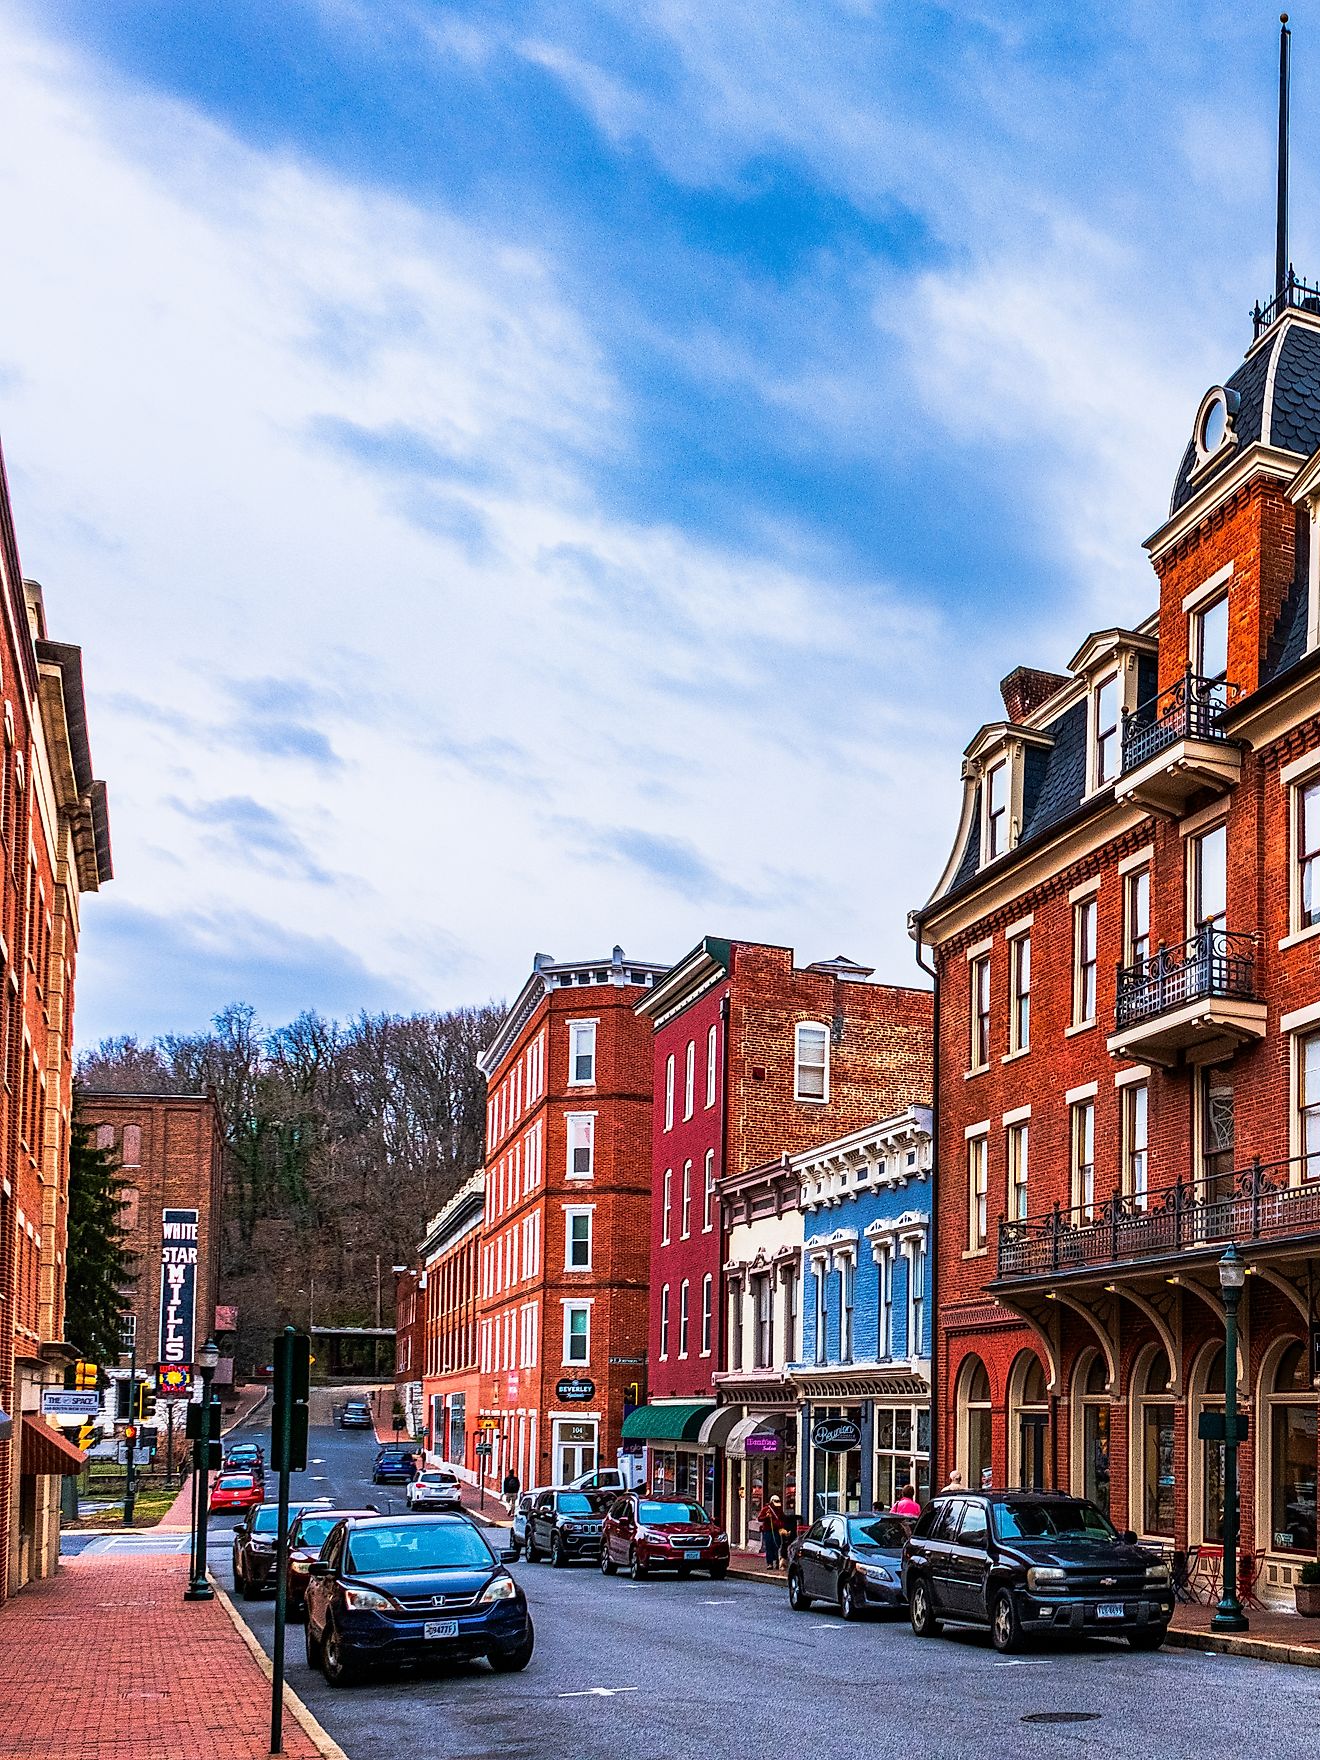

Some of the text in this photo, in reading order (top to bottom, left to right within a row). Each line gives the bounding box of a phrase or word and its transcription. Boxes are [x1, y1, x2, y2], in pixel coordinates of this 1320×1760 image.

[162, 1223, 198, 1239] WHITE
[162, 1247, 197, 1263] STAR
[166, 1264, 186, 1361] MILLS
[48, 1396, 94, 1405] THE SPACE
